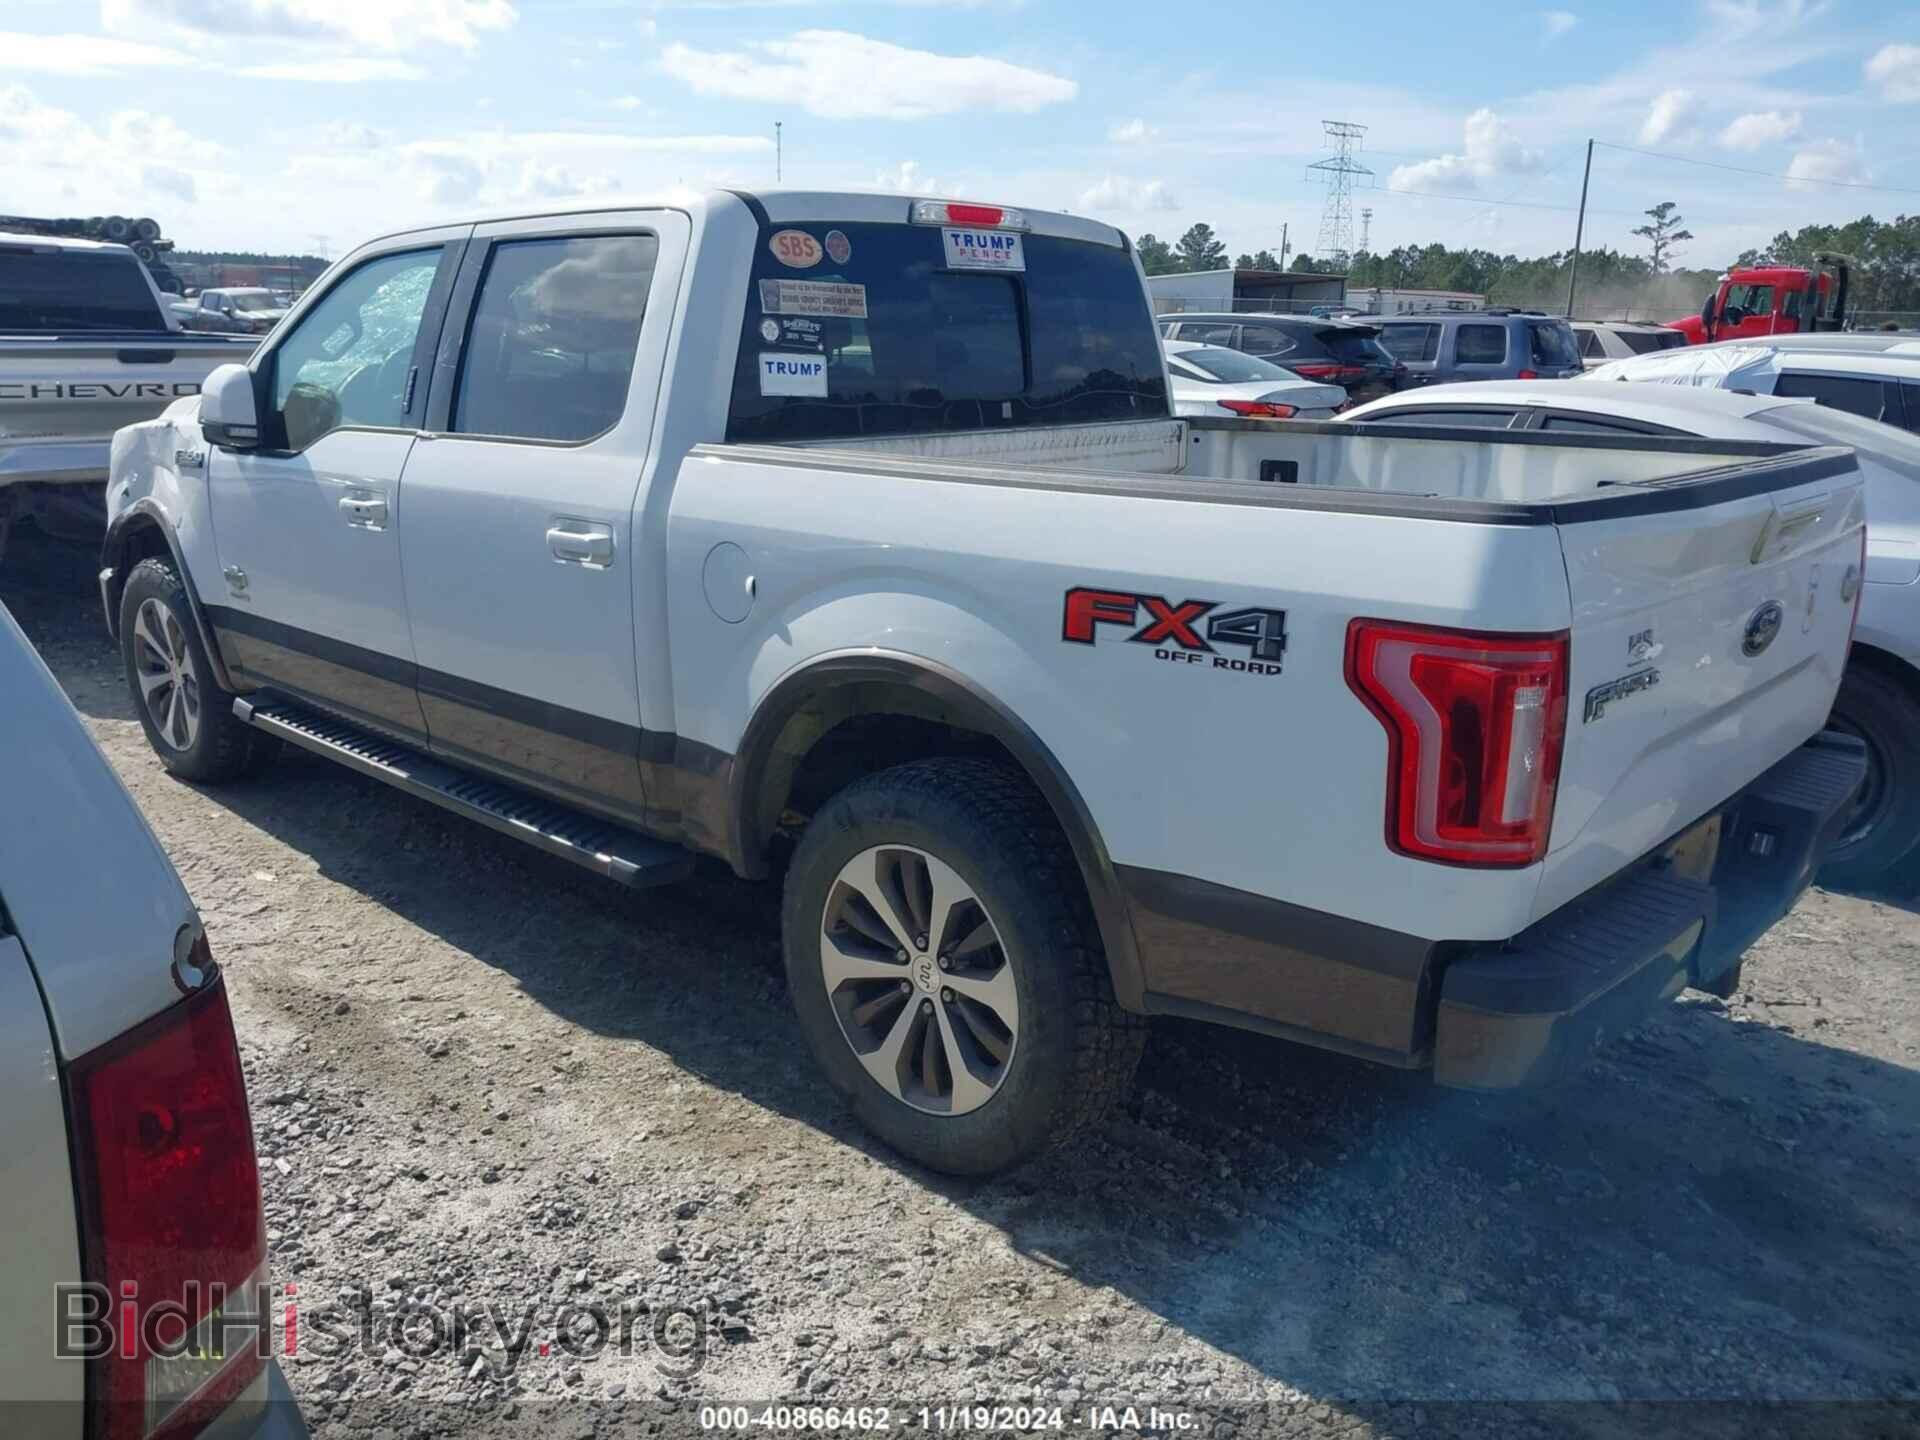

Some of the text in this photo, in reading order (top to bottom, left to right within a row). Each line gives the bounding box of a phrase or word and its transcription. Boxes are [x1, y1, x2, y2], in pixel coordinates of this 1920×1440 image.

[778, 235, 815, 257] SBS
[950, 233, 1015, 250] TRUMP
[959, 248, 1012, 260] PENCE
[765, 361, 822, 376] TRUMP
[1062, 586, 1289, 662] FX4
[1154, 648, 1282, 676] OFF ROAD
